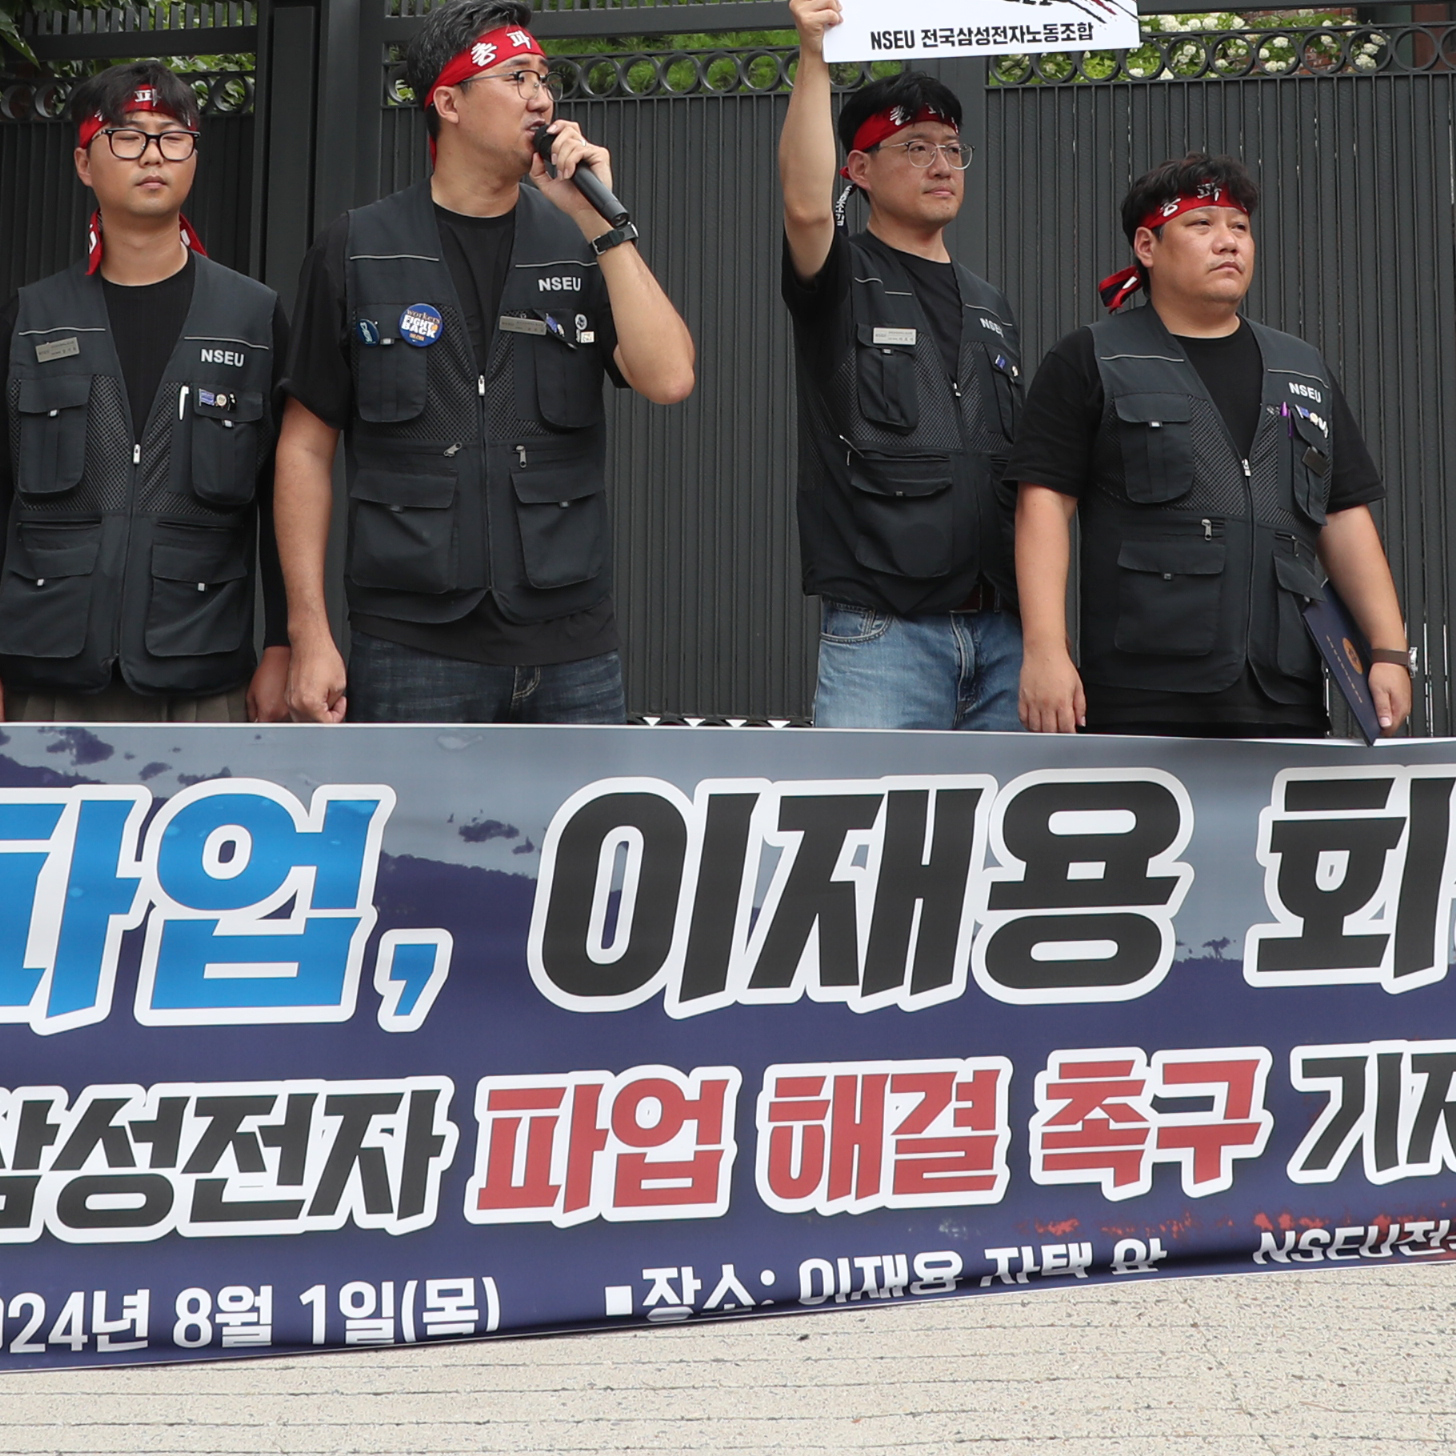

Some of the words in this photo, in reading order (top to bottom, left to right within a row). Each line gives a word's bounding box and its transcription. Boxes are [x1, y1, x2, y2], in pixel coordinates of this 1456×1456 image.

[870, 30, 915, 50] NSEU
[921, 22, 1094, 47] 전국삼성전자노동조합
[538, 276, 581, 292] NSEU
[401, 323, 436, 338] BACK
[201, 348, 245, 368] NSEU
[1288, 382, 1321, 403] NSEU
[527, 767, 1195, 1019] 이재용
[464, 1065, 741, 1228] 파업
[755, 1056, 1012, 1215] 해결
[1029, 1045, 1274, 1202] 촉구
[173, 1283, 273, 1348] 8월
[298, 1276, 501, 1345] 1일(목)
[798, 1250, 963, 1305] 이재용
[980, 1242, 1093, 1287] 자택
